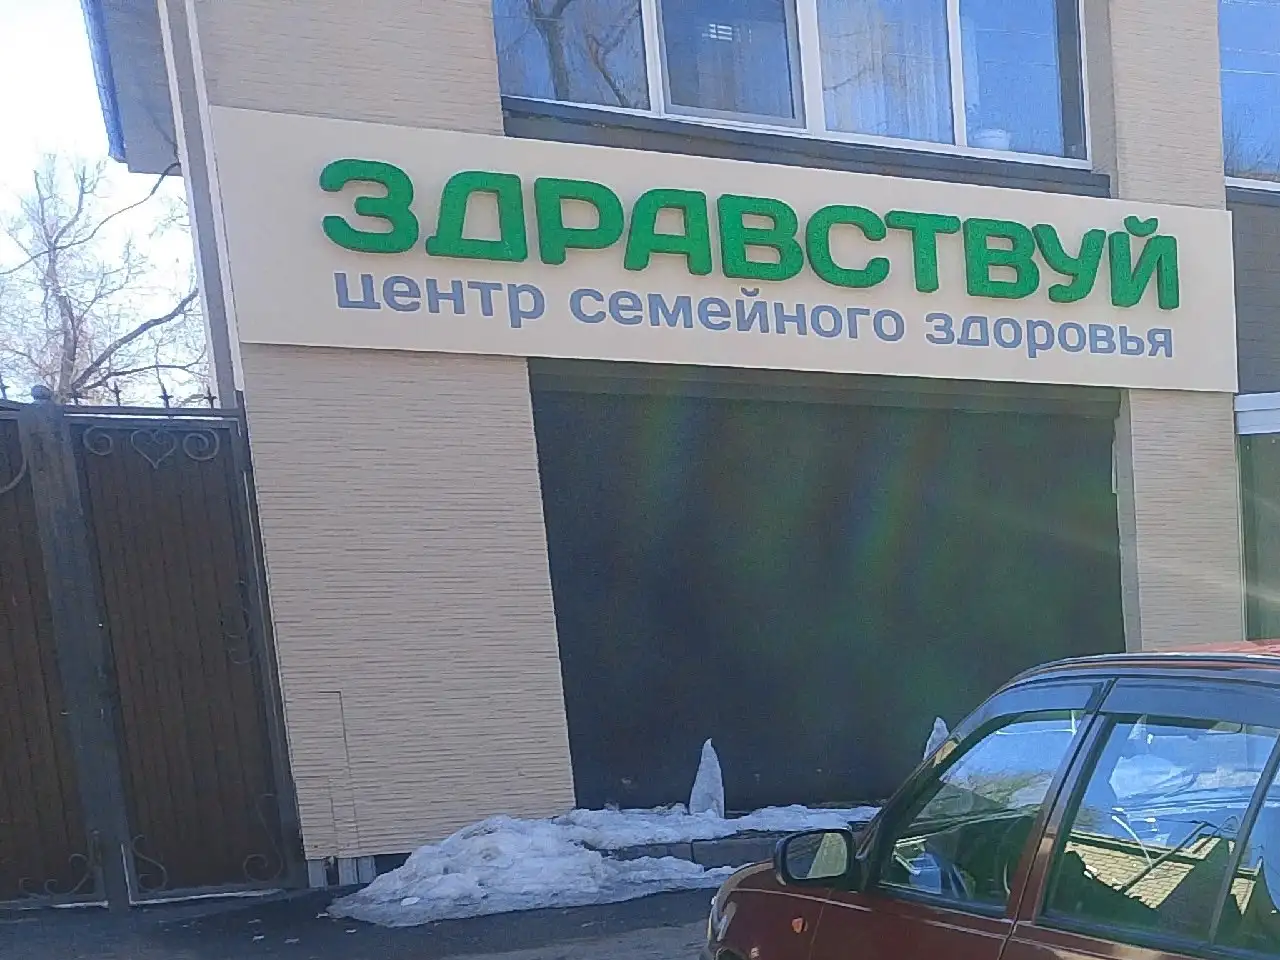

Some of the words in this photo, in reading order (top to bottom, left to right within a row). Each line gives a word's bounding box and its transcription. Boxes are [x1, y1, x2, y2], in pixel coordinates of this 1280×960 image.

[319, 158, 1181, 310] ЗДРАВСТВУЙ
[333, 272, 546, 329] центр
[569, 285, 905, 343] семейного
[924, 312, 1174, 359] здоровья
